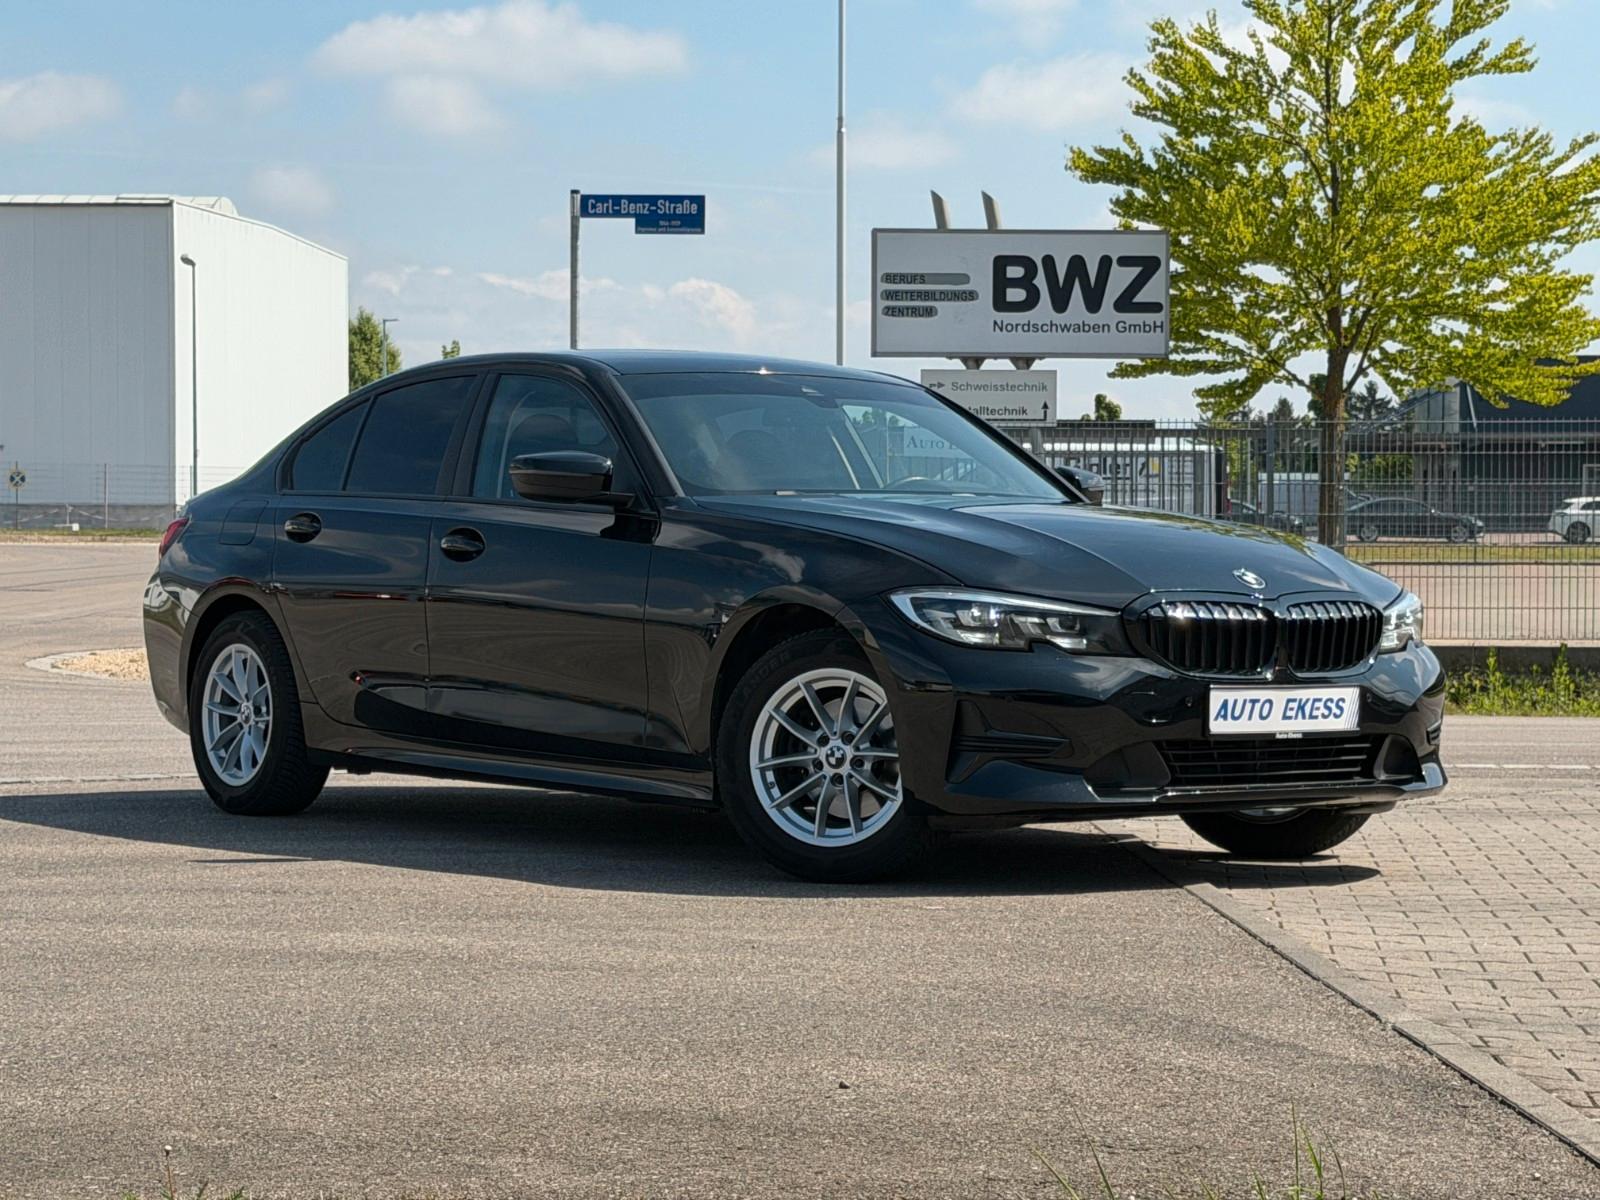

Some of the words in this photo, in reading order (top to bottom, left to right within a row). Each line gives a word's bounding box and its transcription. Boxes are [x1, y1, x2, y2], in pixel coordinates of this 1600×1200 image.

[588, 199, 698, 214] Carl-Benz-Straße
[885, 273, 926, 284] BERUFS
[992, 254, 1164, 314] BWZ
[885, 291, 975, 302] WEITERBILDUNGS
[885, 307, 934, 318] ZENTRUM
[992, 320, 1110, 334] Nordschwaben
[1115, 320, 1164, 334] GmbH
[951, 382, 1048, 392] Schweisstechnik
[1213, 698, 1273, 721] AUTO
[1281, 698, 1346, 720] EKESS
